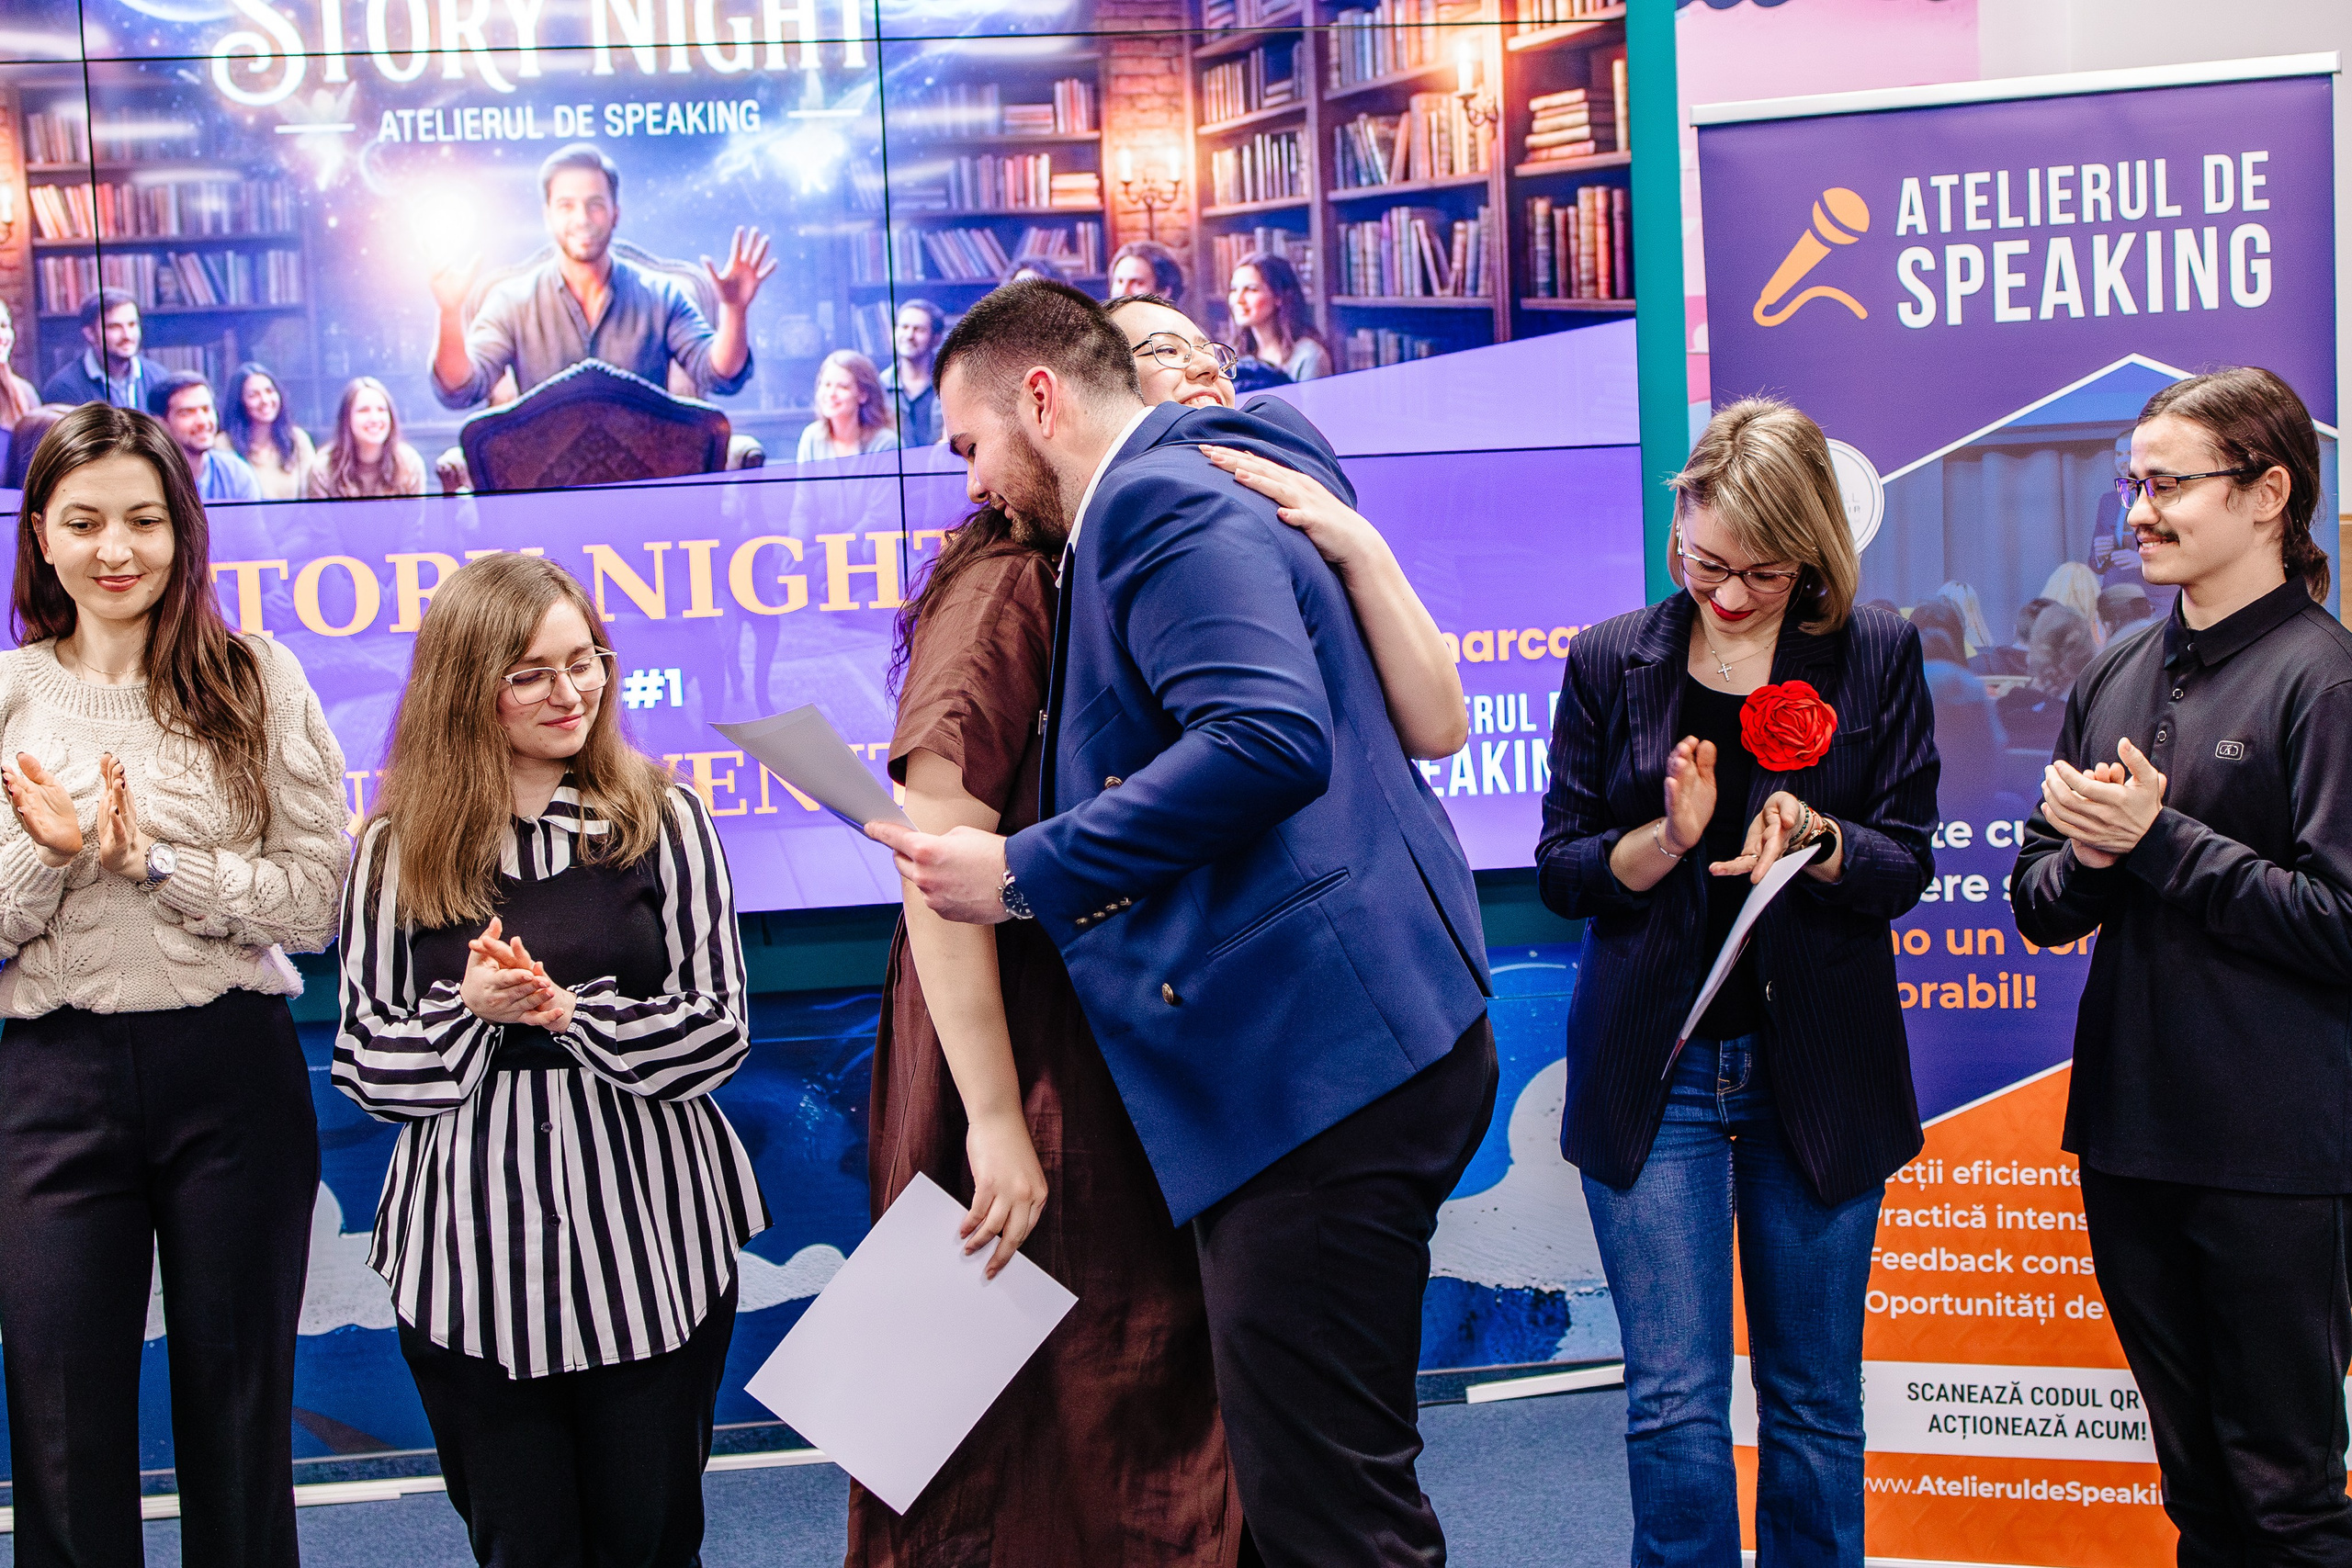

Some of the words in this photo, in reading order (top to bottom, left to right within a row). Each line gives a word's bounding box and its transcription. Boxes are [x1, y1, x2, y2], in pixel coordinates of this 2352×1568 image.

[211, 0, 542, 106] STORY
[591, 0, 867, 75] NIGHT
[378, 104, 544, 143] ATELIERUL
[554, 102, 594, 139] DE
[605, 98, 762, 137] SPEAKING
[1895, 158, 2182, 237] ATELIERUL
[2203, 151, 2270, 216] DE
[1895, 222, 2273, 330] SPEAKING
[209, 547, 545, 637] TOR
[1442, 625, 1592, 663] arca
[622, 668, 684, 709] #1
[1464, 693, 1538, 735] RUL
[1946, 929, 2006, 955] un
[1878, 1202, 1986, 1229] ractică
[1865, 1290, 2055, 1325] Oportunități
[2064, 1294, 2105, 1319] de
[1907, 1382, 2023, 1404] SCANEAZĂ
[2030, 1387, 2103, 1409] CODUL
[2110, 1389, 2140, 1409] QR
[1928, 1414, 2068, 1439] ACȚIONEAZĂ
[2075, 1420, 2147, 1440] ACUM!
[1864, 1475, 2164, 1506] ww.AtelieruldeSpeaki
